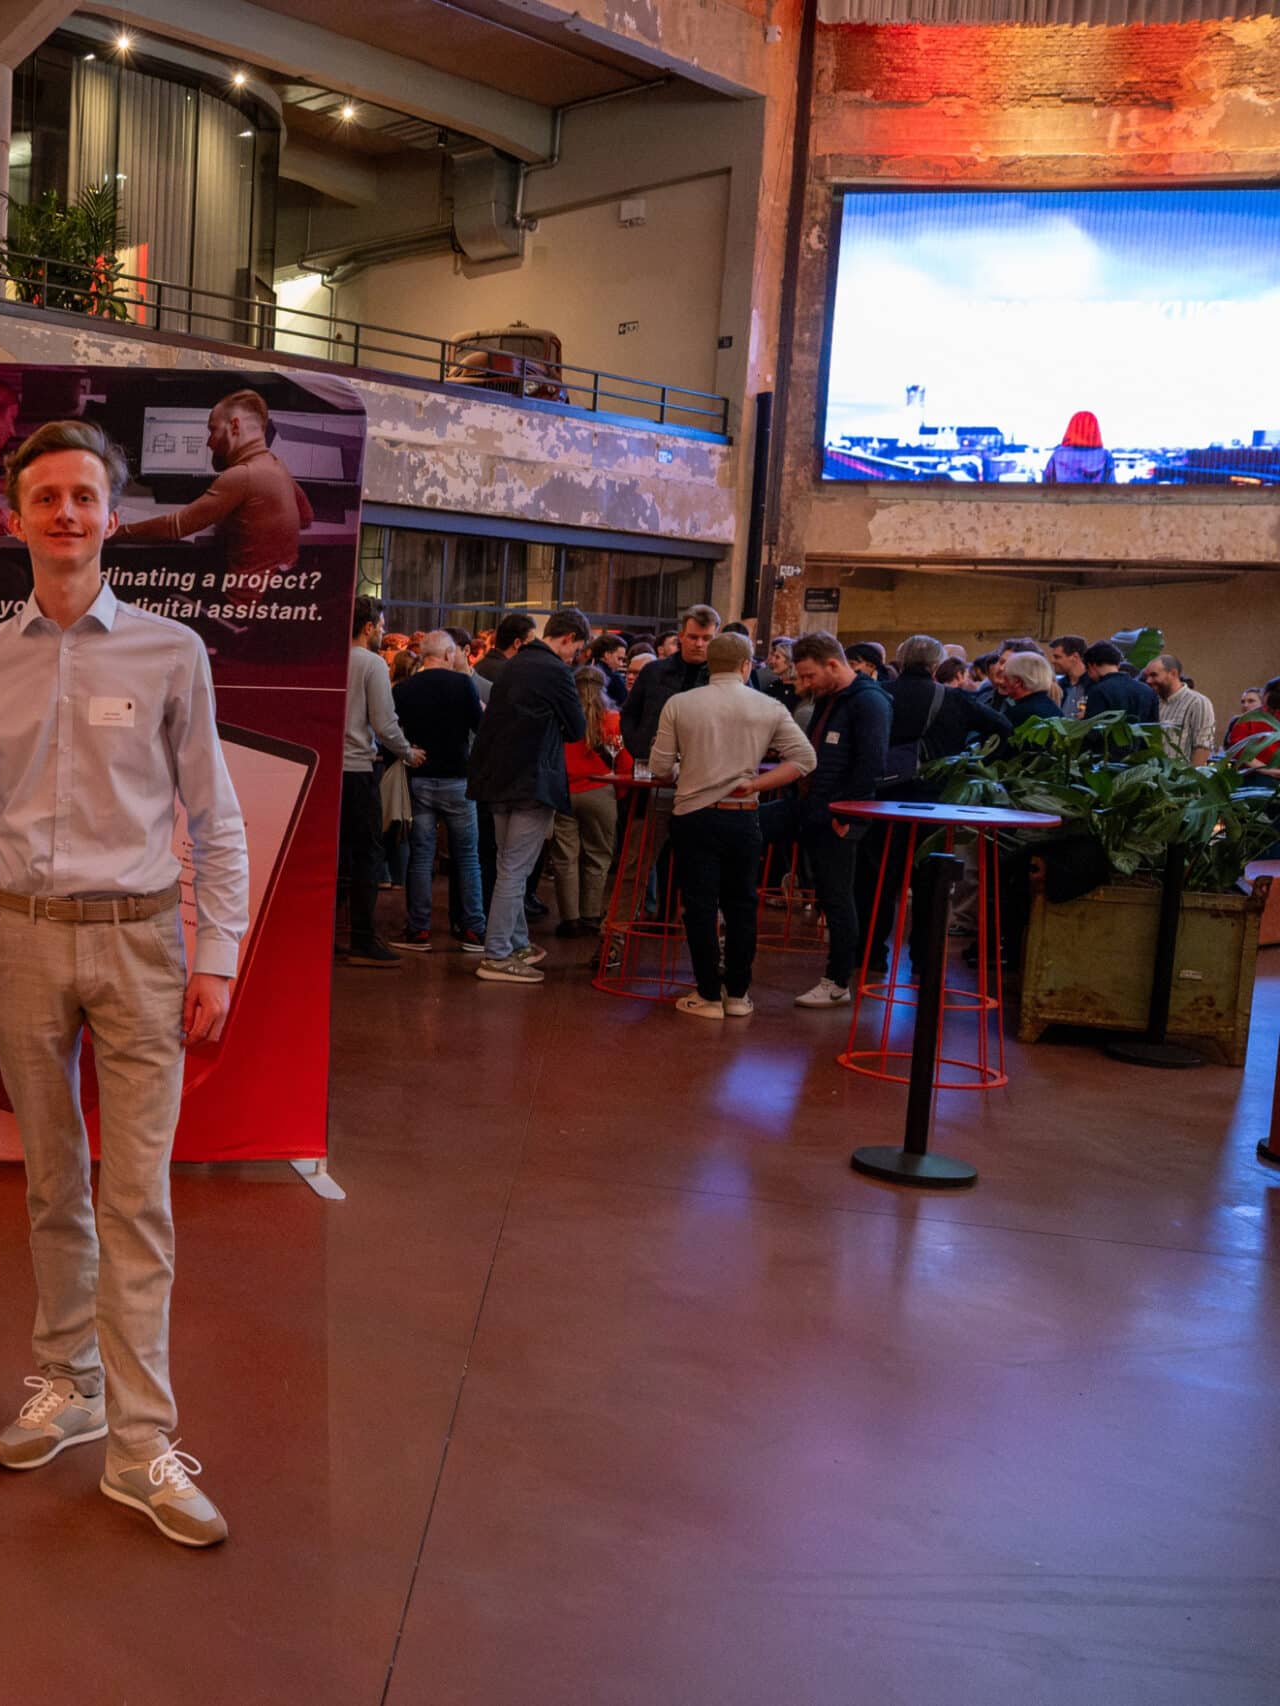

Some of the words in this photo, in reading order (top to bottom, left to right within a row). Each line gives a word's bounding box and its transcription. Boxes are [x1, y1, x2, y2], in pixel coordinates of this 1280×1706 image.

[202, 573, 216, 588] a
[221, 569, 322, 593] project?
[207, 600, 322, 621] assistant.
